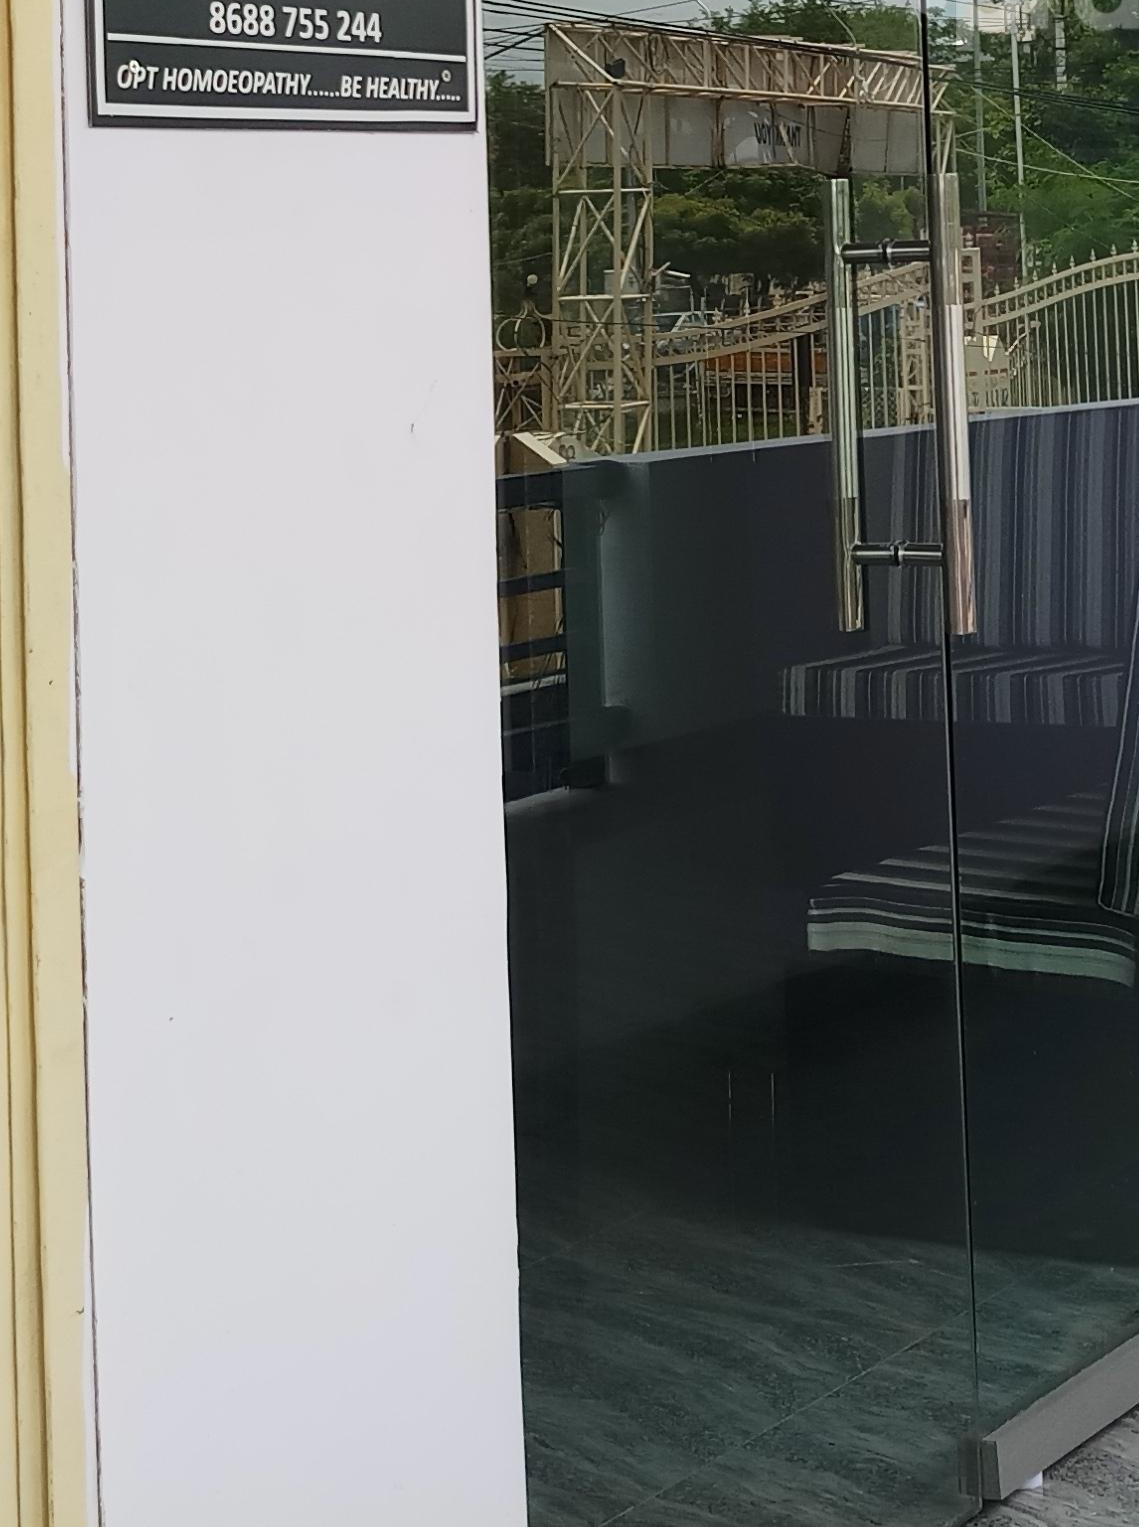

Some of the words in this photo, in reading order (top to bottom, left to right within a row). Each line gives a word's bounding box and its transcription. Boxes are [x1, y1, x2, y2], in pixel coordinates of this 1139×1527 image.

[209, 2, 275, 37] 8688
[282, 6, 329, 41] 755
[336, 8, 382, 44] 244
[117, 62, 159, 90] OPT
